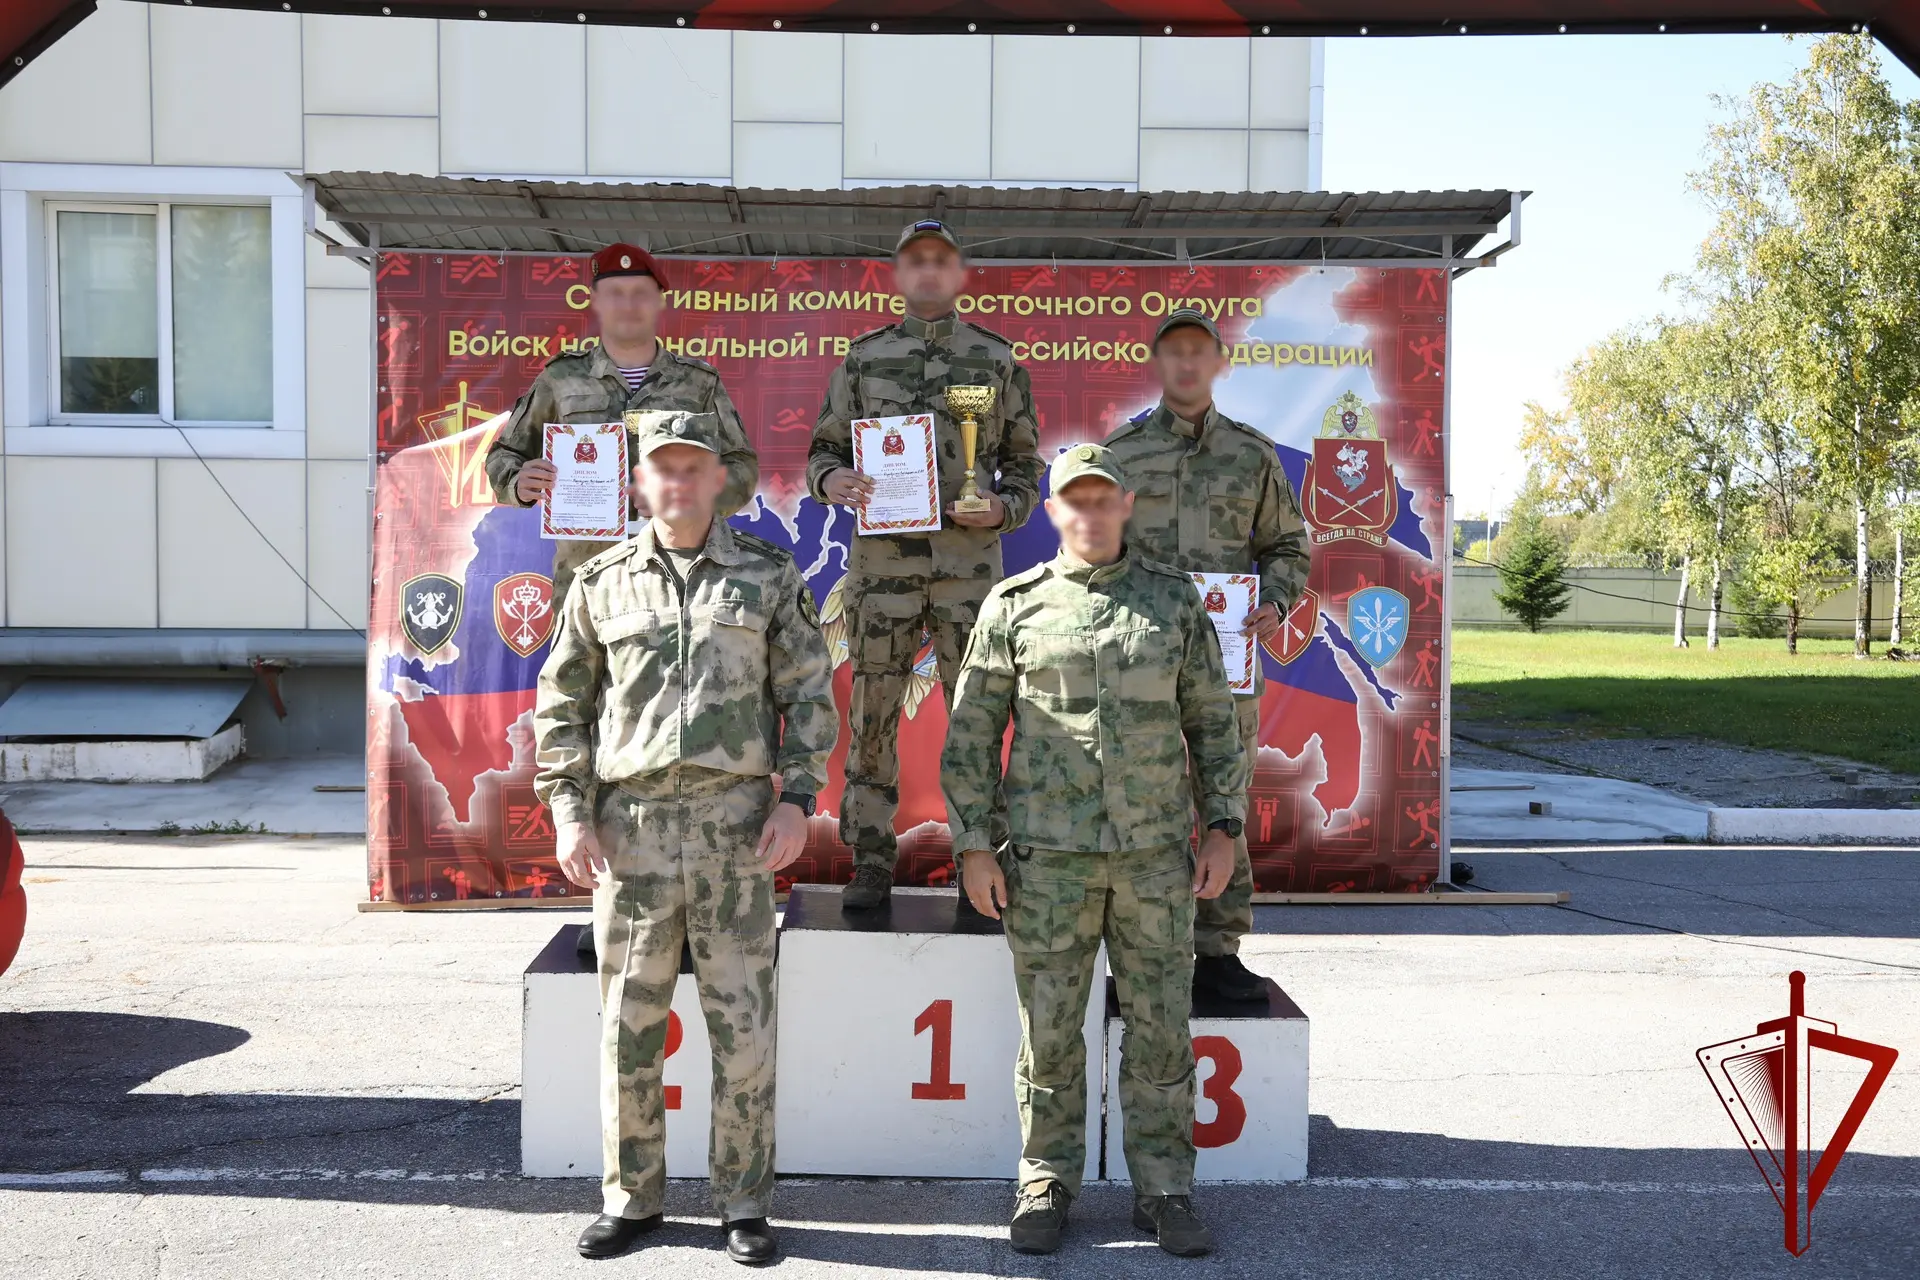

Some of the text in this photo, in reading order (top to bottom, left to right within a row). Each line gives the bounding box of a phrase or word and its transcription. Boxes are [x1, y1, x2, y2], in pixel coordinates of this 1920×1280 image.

[565, 284, 778, 312] Стивный
[788, 290, 907, 315] комите
[954, 293, 1132, 316] осточного
[448, 330, 551, 357] Войск
[560, 331, 808, 358] нанальной
[1010, 336, 1152, 363] ссийско
[1227, 342, 1374, 368] дерации
[1316, 528, 1383, 545] ВСЕГДА НА СТРАЖЕ
[911, 999, 966, 1101] 1
[1192, 1035, 1247, 1149] 3
